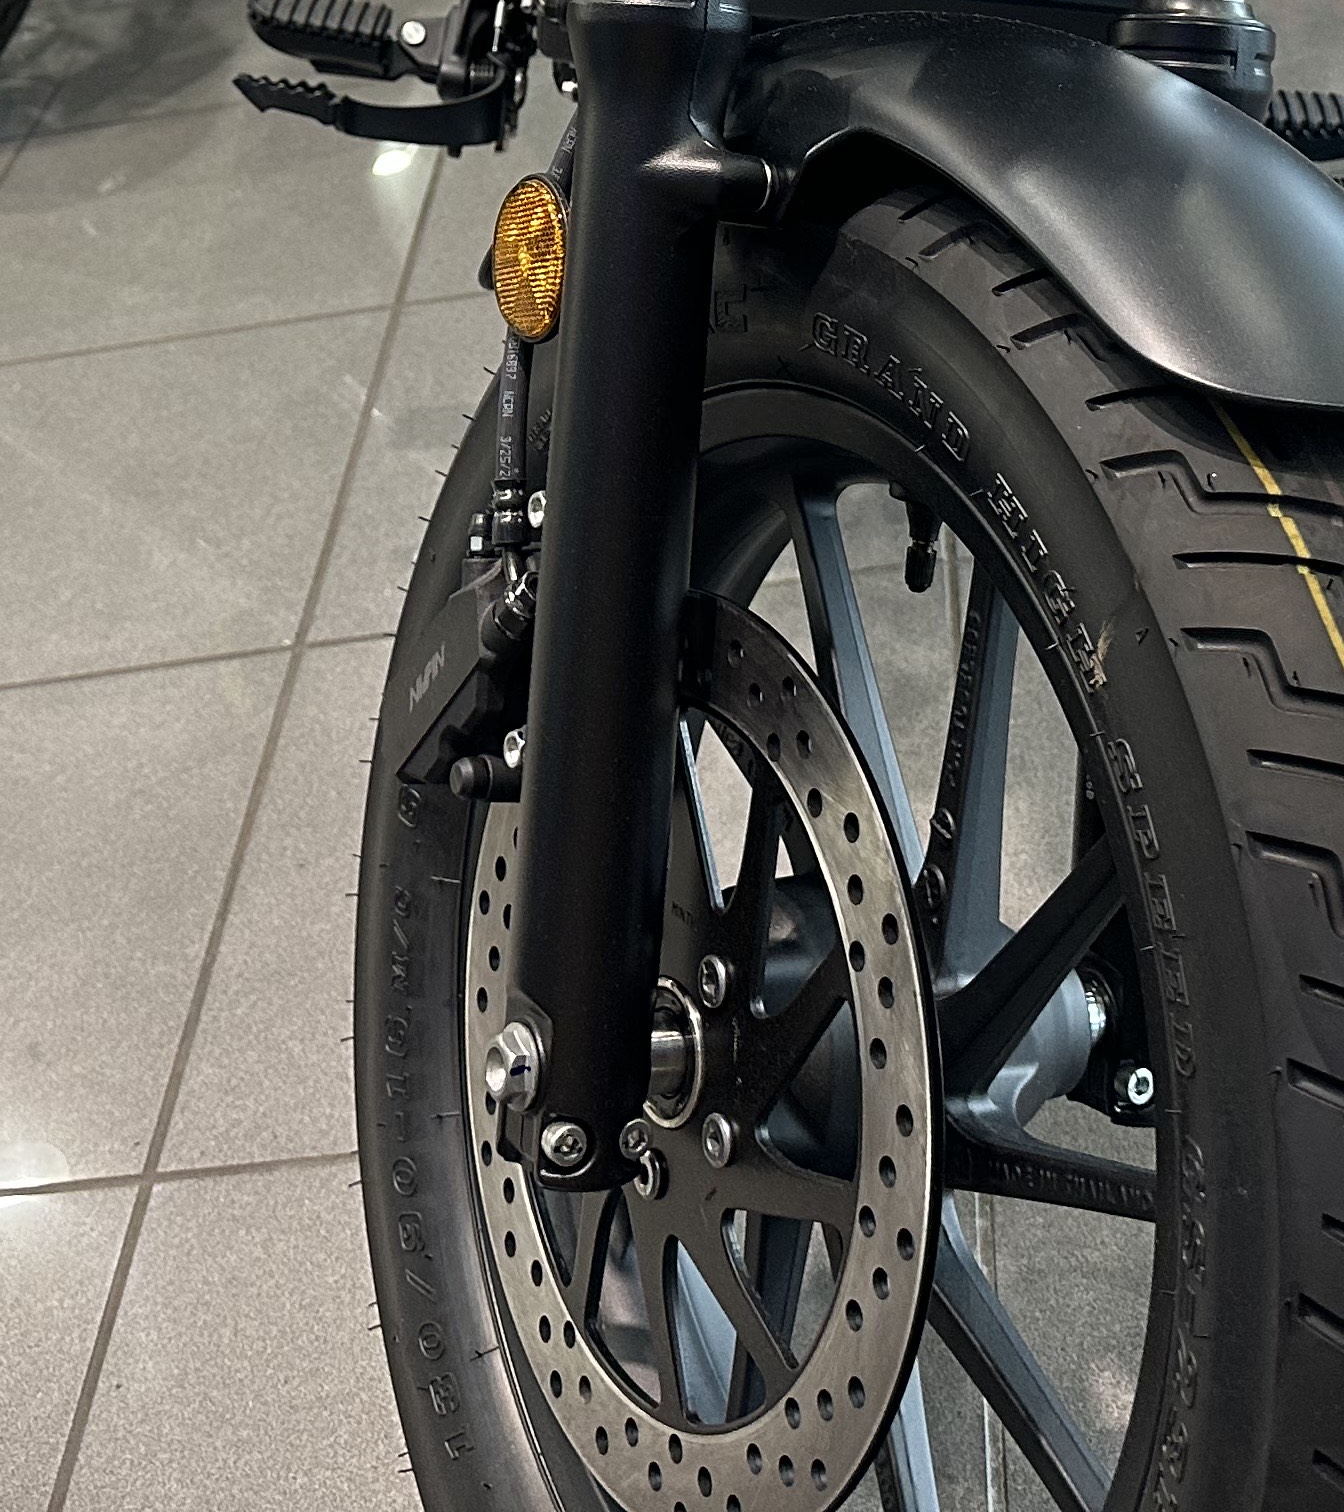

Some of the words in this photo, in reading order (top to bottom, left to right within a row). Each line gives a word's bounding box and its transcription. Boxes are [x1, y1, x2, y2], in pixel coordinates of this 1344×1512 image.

[811, 311, 972, 463] GRAND
[986, 472, 1108, 695] HIGH
[1106, 737, 1197, 1079] SPEED
